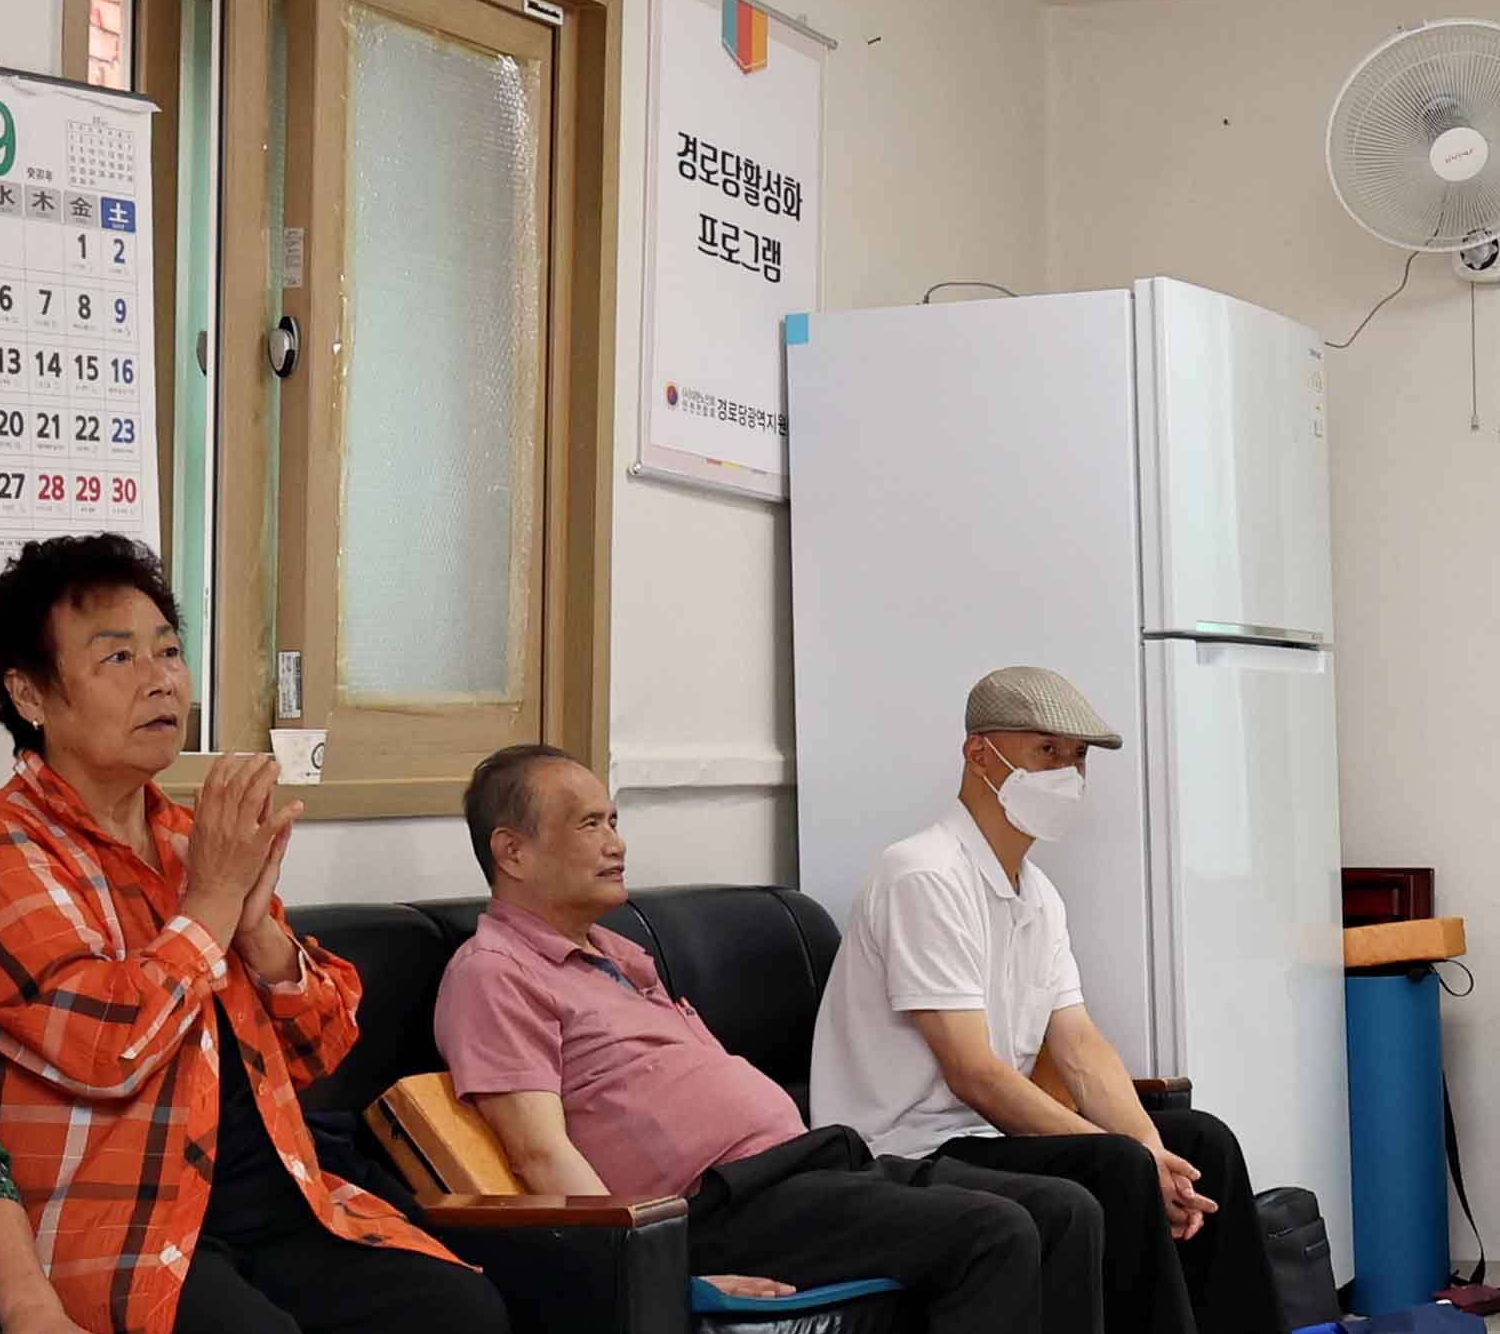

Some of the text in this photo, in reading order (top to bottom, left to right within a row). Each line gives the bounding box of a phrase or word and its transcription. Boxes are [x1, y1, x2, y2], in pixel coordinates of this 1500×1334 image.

[677, 131, 802, 222] 경로당활성화
[31, 189, 54, 212] 木
[70, 197, 93, 218] 金
[109, 202, 129, 224] 土
[77, 234, 125, 264] 1 2
[698, 213, 781, 283] 프로그램
[0, 285, 13, 312] 6
[38, 289, 52, 316] 7
[78, 294, 91, 320] 8
[114, 298, 127, 324] 9
[35, 351, 62, 378] 14
[75, 354, 99, 381] 15
[111, 358, 134, 384] 16
[37, 413, 61, 440] 21
[75, 415, 100, 442] 22
[111, 418, 135, 444] 23
[38, 475, 65, 501] 28
[75, 476, 101, 502] 29
[112, 478, 137, 504] 30
